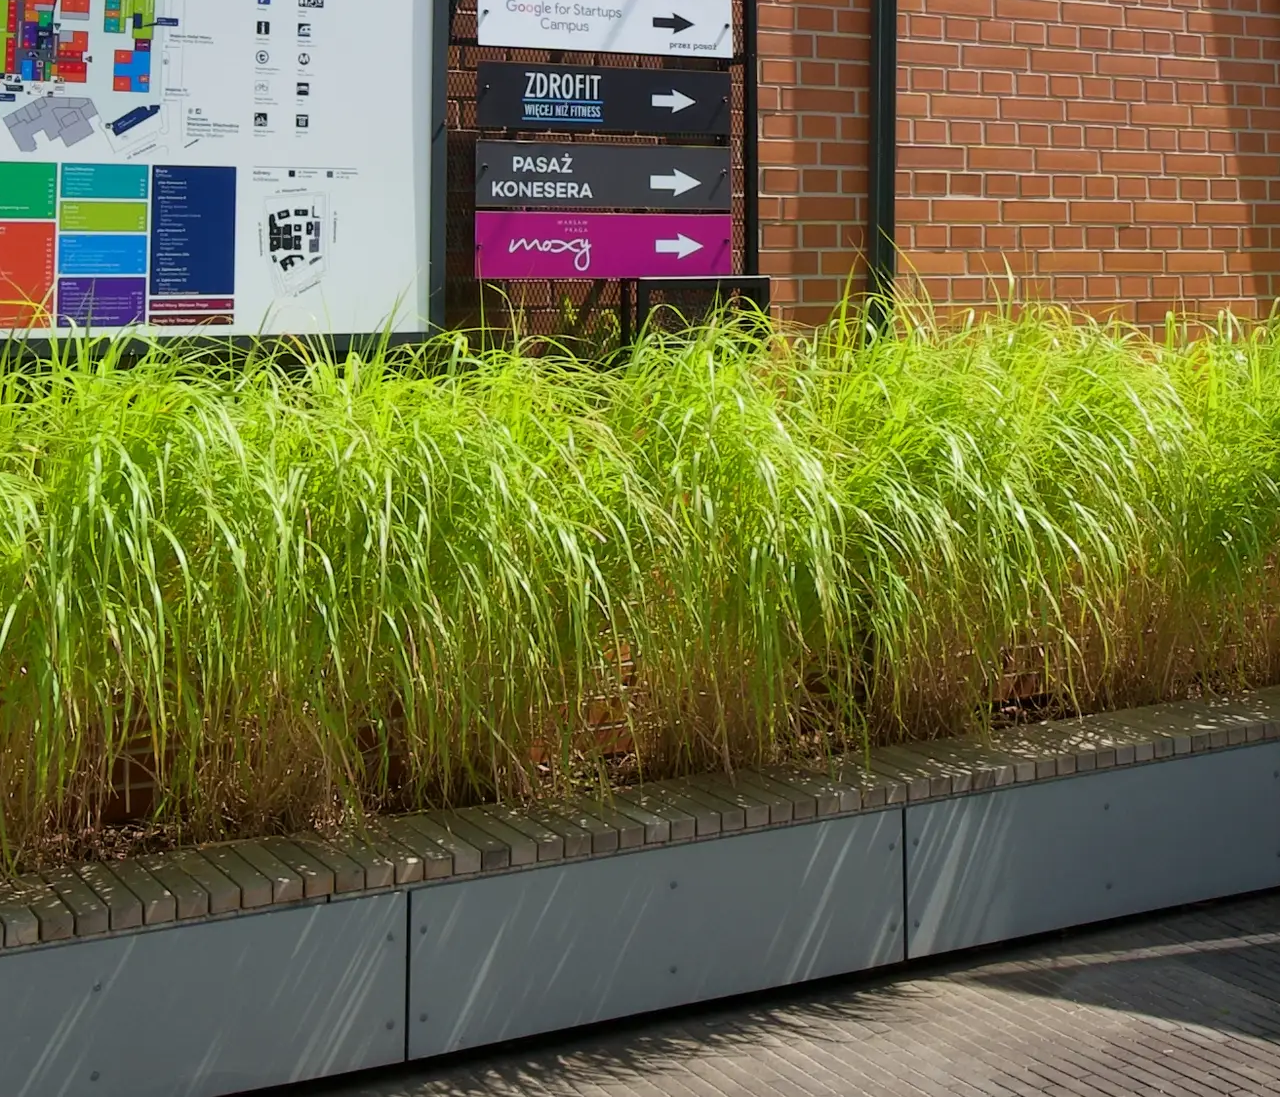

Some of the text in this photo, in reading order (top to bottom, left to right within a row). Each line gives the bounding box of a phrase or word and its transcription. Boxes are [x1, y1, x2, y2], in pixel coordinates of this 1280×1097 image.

[506, 0, 622, 19] Google for Startups
[540, 17, 589, 33] Campus
[669, 42, 717, 51] przez pasaż
[524, 72, 601, 100] ZDROFIT
[524, 102, 601, 118] WIĘCEJ NIŻ FITNESS
[513, 153, 572, 173] PASAŻ
[492, 181, 593, 198] KONESERA
[509, 237, 591, 271] moxy
